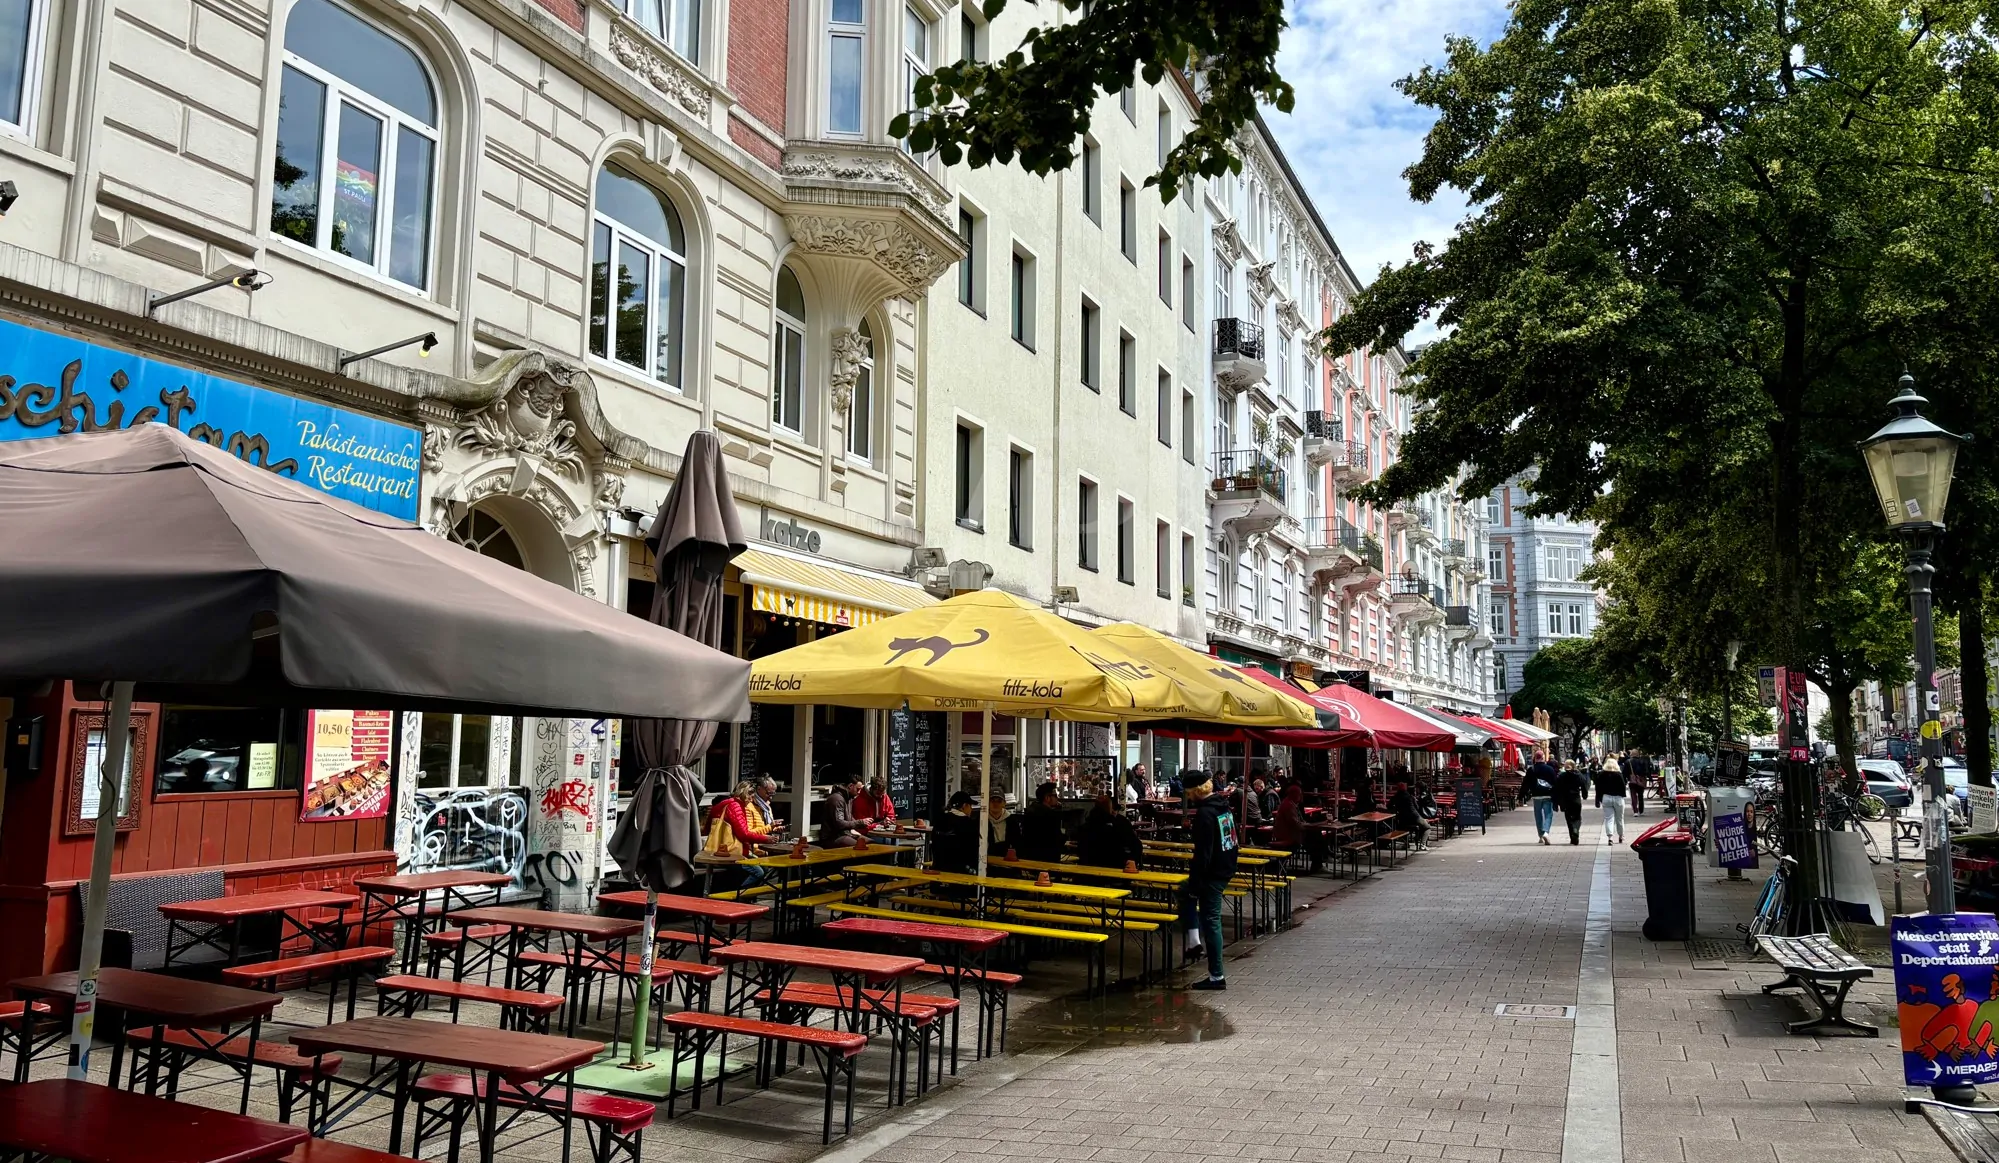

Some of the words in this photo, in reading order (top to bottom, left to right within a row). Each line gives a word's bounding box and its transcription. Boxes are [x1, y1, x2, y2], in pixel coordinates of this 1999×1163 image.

[297, 420, 419, 471] Pakistanisches
[307, 455, 416, 499] Restaurant
[760, 505, 821, 553] katze
[749, 674, 802, 691] fritz-kola
[1002, 678, 1063, 698] fritz-kola
[317, 724, 343, 736] 10,50
[345, 725, 351, 735] €
[361, 789, 387, 814] SCHANZE
[370, 802, 382, 814] TIP
[1716, 825, 1745, 838] WÜRDE
[1719, 834, 1748, 853] VOLL
[1720, 847, 1749, 863] HELFEN
[1896, 930, 1999, 942] Menschenrechte
[1939, 942, 1971, 954] statt
[1901, 954, 1999, 968] Deportationen!
[1946, 1062, 1998, 1075] MERA25
